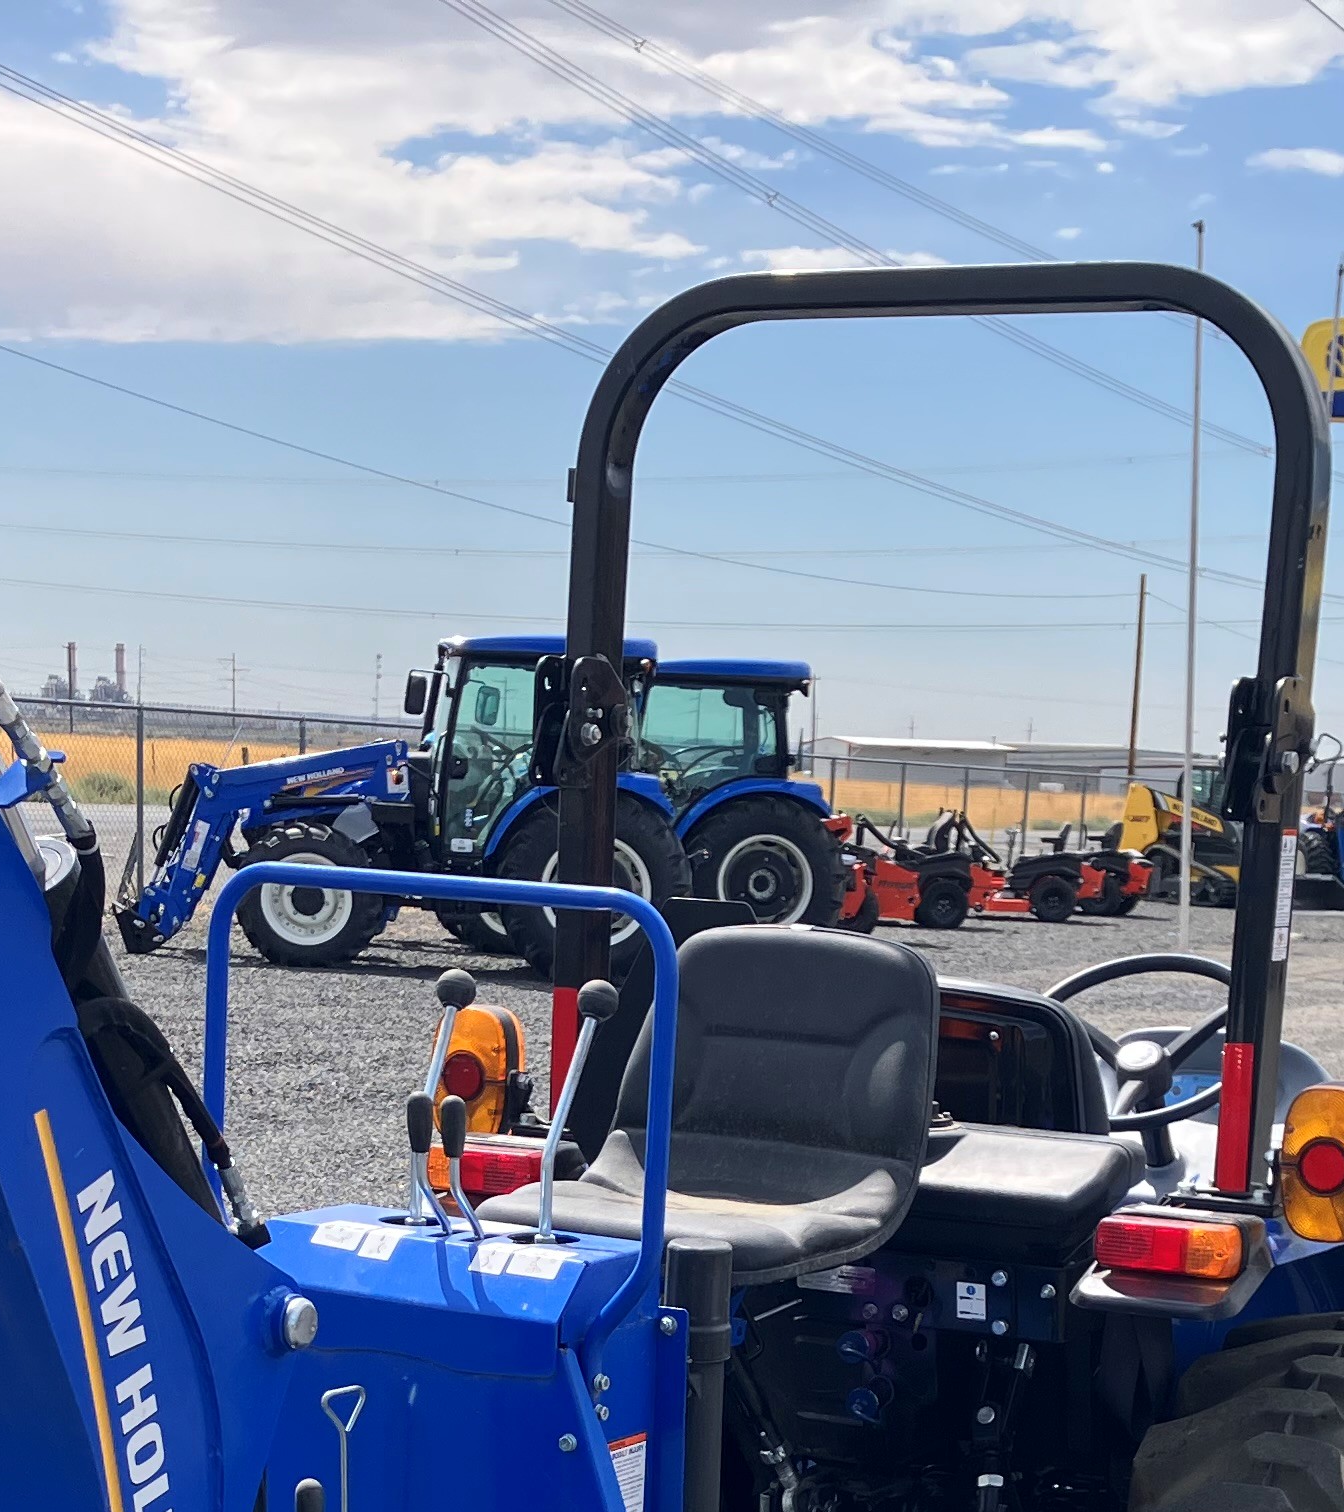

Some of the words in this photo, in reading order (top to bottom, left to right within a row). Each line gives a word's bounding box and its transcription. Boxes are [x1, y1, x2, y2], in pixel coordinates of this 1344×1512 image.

[286, 774, 306, 785] NEW
[306, 766, 345, 781] HOLLAND
[77, 1168, 147, 1357] NEW
